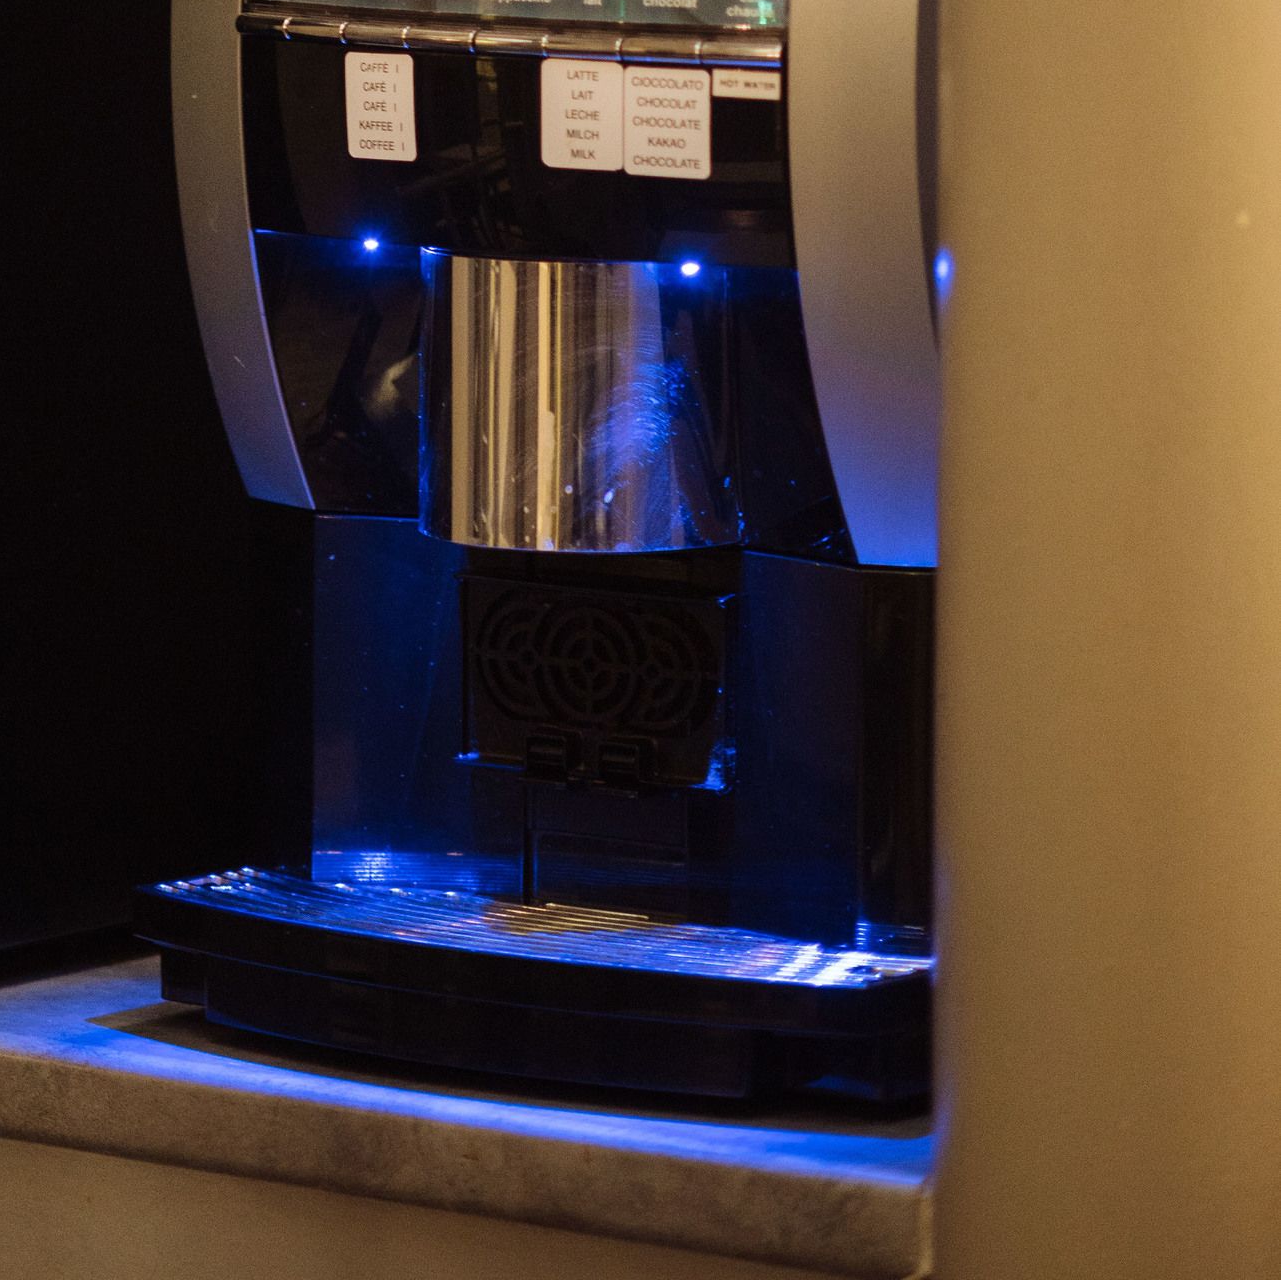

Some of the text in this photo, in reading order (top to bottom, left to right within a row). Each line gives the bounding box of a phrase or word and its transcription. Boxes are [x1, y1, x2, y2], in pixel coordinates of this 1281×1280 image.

[726, 4, 775, 17] chau
[567, 69, 599, 82] LATTE
[631, 76, 704, 91] CIOCCOLATO
[571, 90, 594, 101] LAIT
[636, 96, 698, 110] CHOCOLAT
[565, 109, 600, 121] LECHE
[359, 120, 394, 132] KAFFEE
[632, 115, 702, 130] CHOCOLATE
[566, 128, 599, 141] MILCH
[359, 139, 395, 151] COFFEE
[647, 136, 687, 149] KAKAO
[571, 148, 596, 160] MILK
[633, 155, 702, 170] CHOCOLATE
